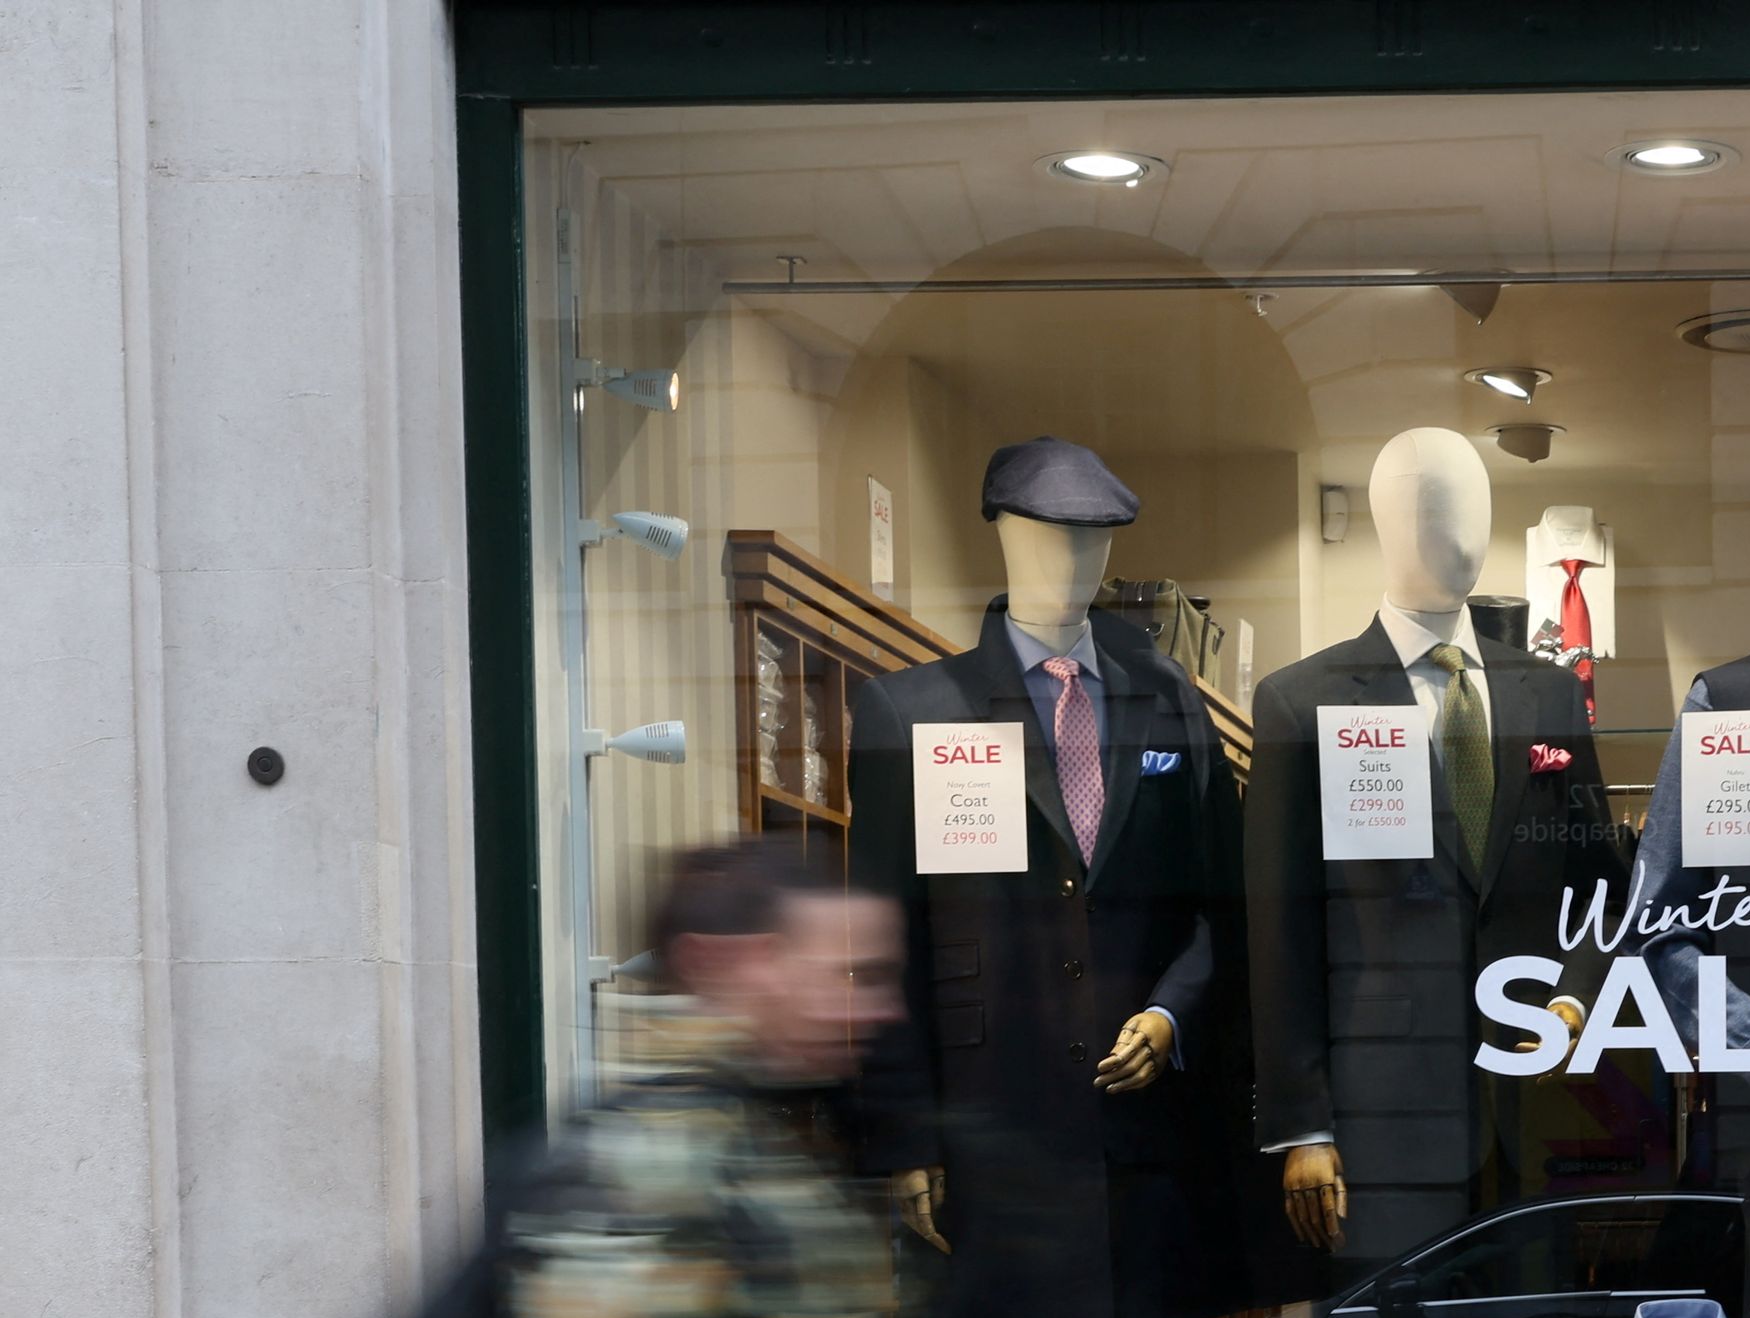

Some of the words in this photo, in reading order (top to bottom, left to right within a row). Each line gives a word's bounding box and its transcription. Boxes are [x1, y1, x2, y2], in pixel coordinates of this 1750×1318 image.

[1351, 715, 1392, 728] Winter
[947, 732, 989, 745] Winter
[1338, 729, 1406, 748] SALE
[933, 745, 1001, 764] SALE
[1359, 760, 1391, 772] Suits
[1349, 779, 1403, 792] £550.00
[1721, 780, 1750, 792] Gilet
[950, 794, 988, 807] Coat
[1350, 799, 1404, 811] £299.00
[945, 814, 995, 826] £495.00
[1368, 817, 1406, 826] £550.00
[943, 832, 997, 845] £399.00
